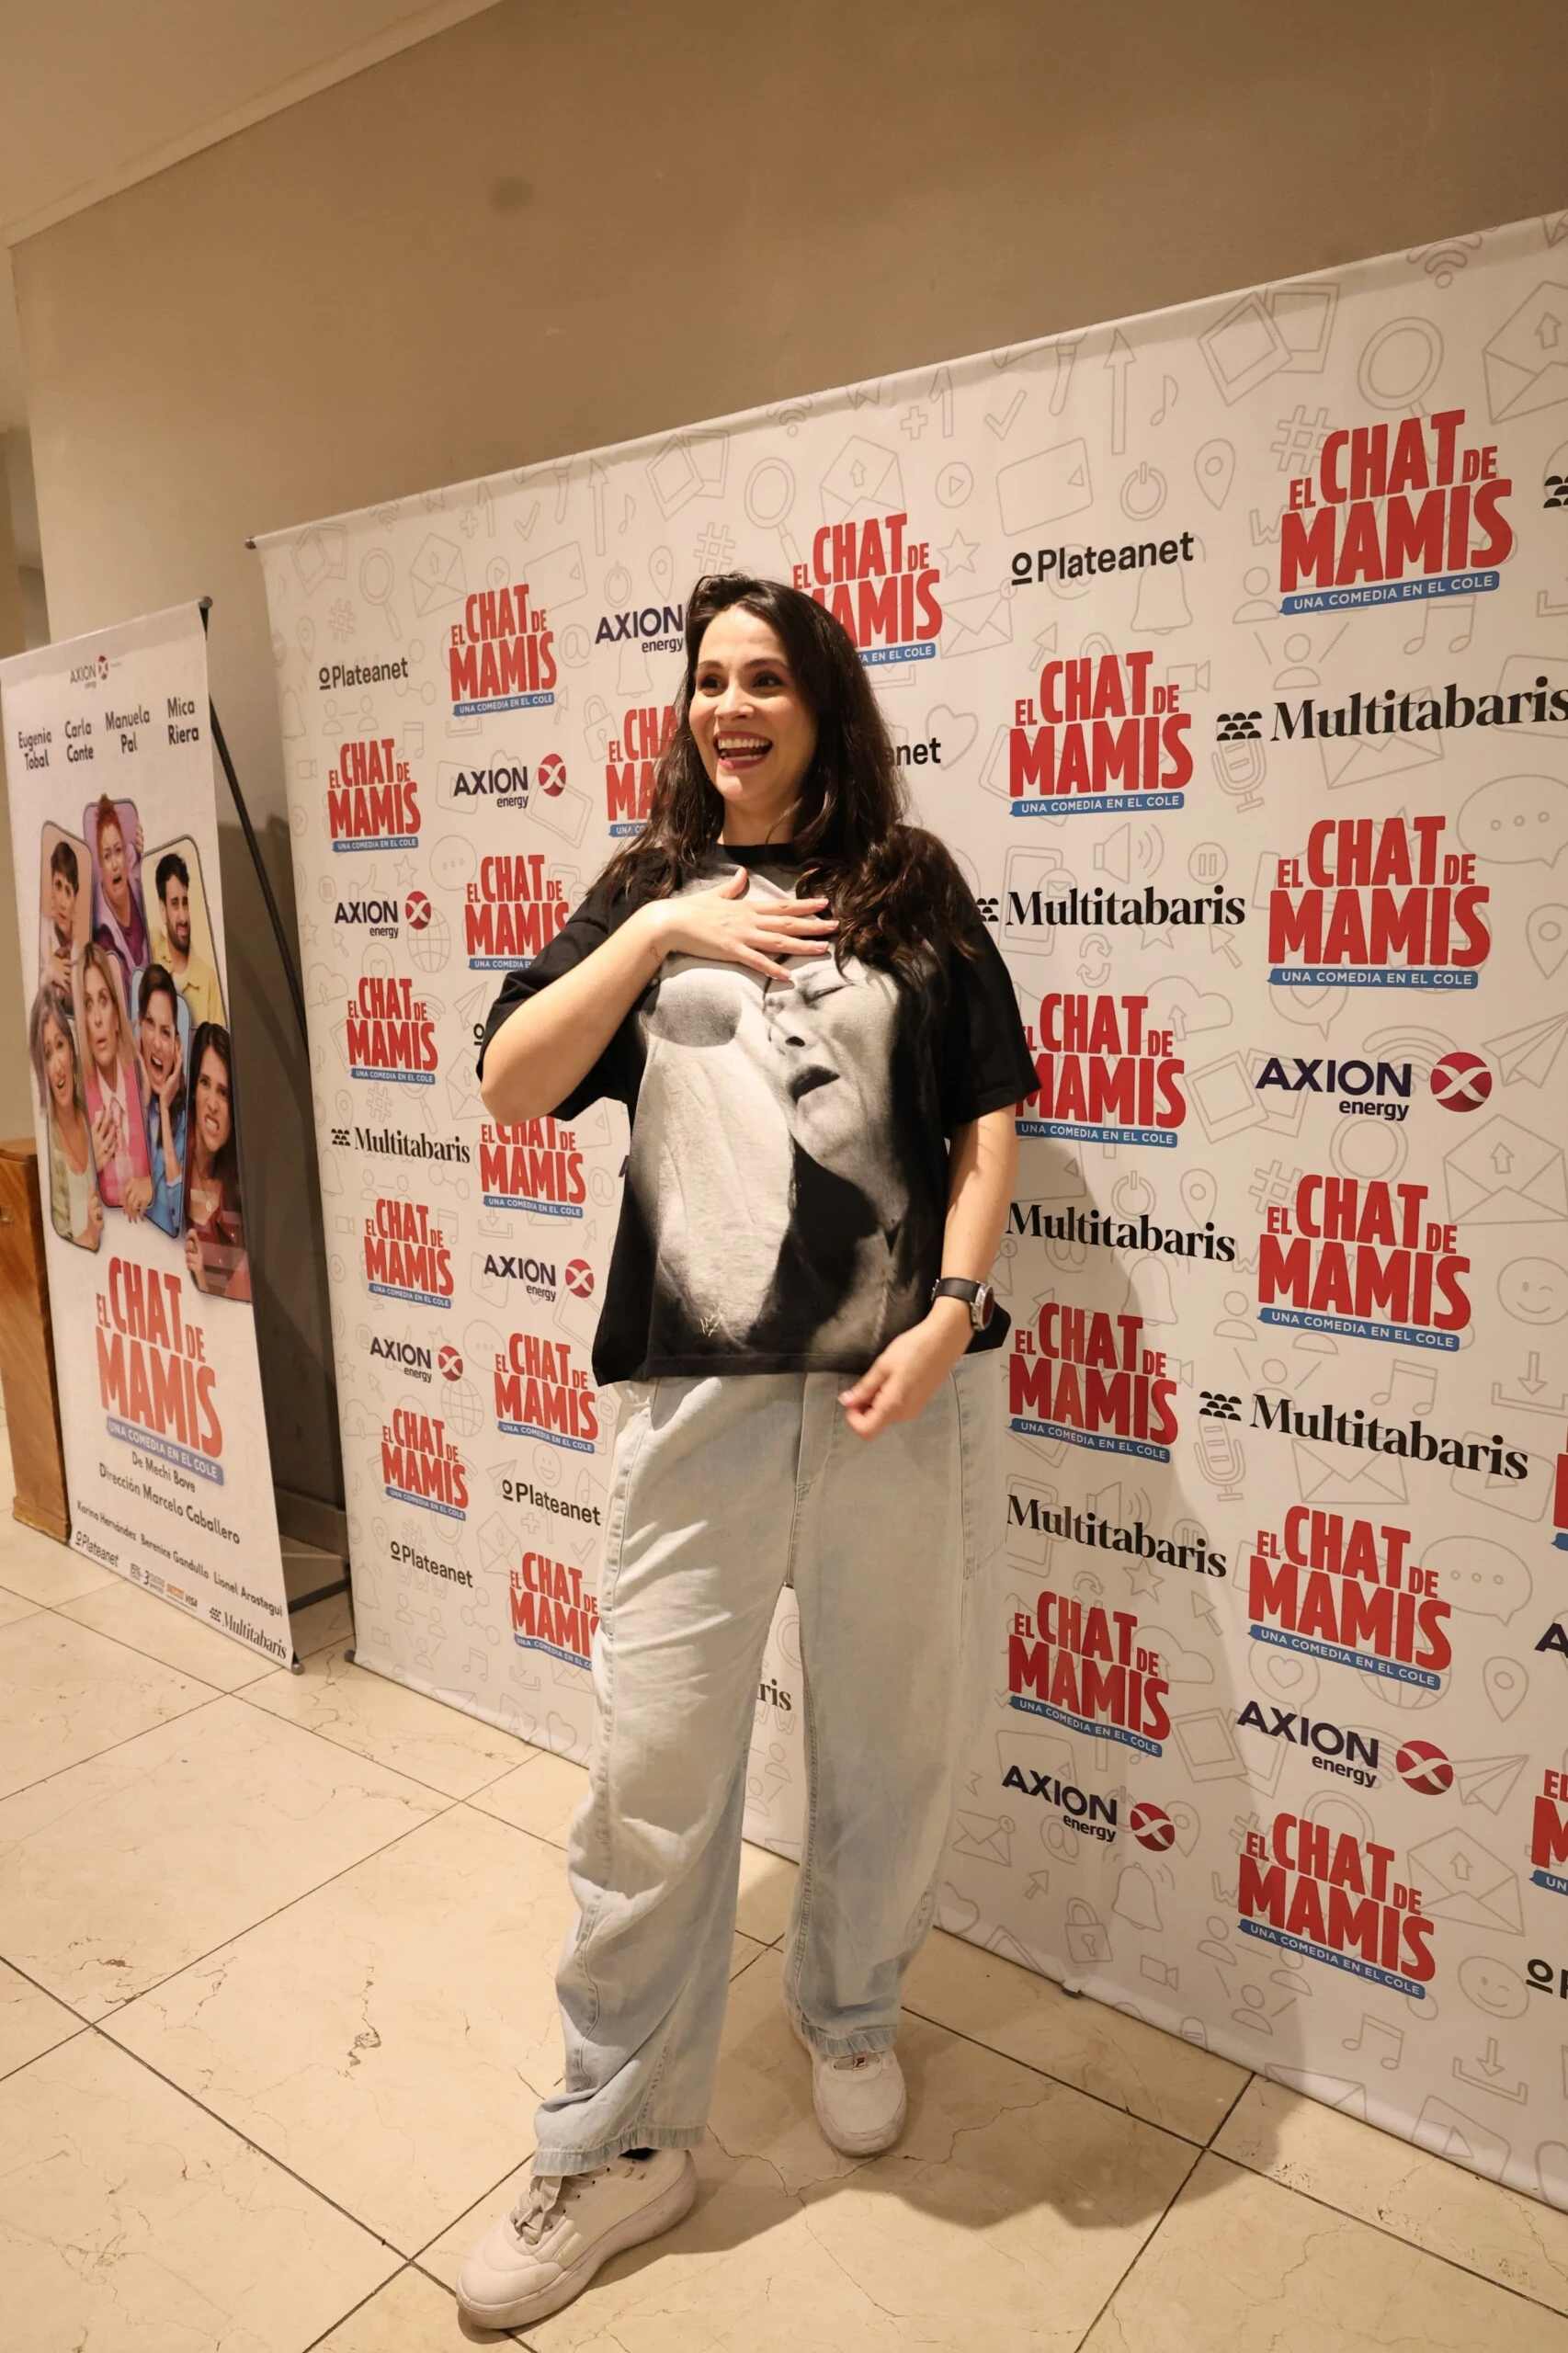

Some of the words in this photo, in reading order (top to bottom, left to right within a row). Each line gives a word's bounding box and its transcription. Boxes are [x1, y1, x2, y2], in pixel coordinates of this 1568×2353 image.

[1290, 478, 1314, 510] EL
[1320, 410, 1465, 505] CHAT
[1462, 446, 1496, 483] DE
[793, 563, 812, 591] EL
[812, 513, 907, 585] CHAT
[907, 542, 929, 572] DE
[1280, 479, 1512, 592] MAMIS
[452, 624, 465, 646] EL
[465, 585, 529, 643] CHAT
[530, 609, 547, 632] DE
[811, 569, 943, 648] AMIS
[1294, 597, 1324, 611] UNA
[1329, 588, 1397, 607] COMEDIA
[1403, 585, 1422, 597] EN
[1428, 582, 1445, 594] EL
[1451, 575, 1493, 591] COLE
[596, 605, 683, 643] AXION
[642, 637, 683, 654] energy
[449, 631, 558, 701] MAMIS
[1017, 699, 1036, 726] EL
[1040, 651, 1153, 724] CHAT
[1152, 684, 1179, 714] DE
[65, 720, 91, 739] Carla
[106, 705, 150, 732] Manuela
[167, 698, 195, 718] Mica
[168, 724, 199, 745] Riera
[608, 740, 623, 763] EL
[624, 706, 679, 761] CHA
[1271, 676, 1568, 741] Multitabaris
[18, 727, 51, 752] Eugenia
[24, 749, 49, 770] Tobal
[67, 744, 94, 763] Conte
[121, 733, 137, 754] Pal
[329, 770, 341, 790] EL
[340, 738, 395, 788] CHAT
[396, 762, 411, 782] DE
[1010, 713, 1193, 797] MAMIS
[454, 767, 528, 796] AXION
[497, 796, 528, 810] energy
[1022, 804, 1045, 813] UNA
[1050, 801, 1104, 813] COMEDIA
[1108, 799, 1123, 810] EN
[1128, 798, 1142, 808] EL
[1146, 796, 1179, 807] COLE
[328, 782, 421, 838] MAMIS
[467, 883, 481, 903] EL
[481, 855, 544, 903] CHAT
[546, 881, 562, 901] DE
[1278, 859, 1302, 888] EL
[1307, 816, 1446, 888] CHAT
[1443, 855, 1475, 885] DE
[335, 901, 398, 924] AXION
[369, 926, 399, 938] energy
[1006, 885, 1245, 925] Multitabaris
[1269, 886, 1490, 966] MAMIS
[347, 1001, 359, 1018] EL
[358, 977, 413, 1020] CHAT
[414, 1002, 427, 1021] DE
[1282, 973, 1311, 983] UNA
[1316, 972, 1381, 984] COMEDIA
[1387, 974, 1405, 984] EN
[1411, 974, 1427, 984] EL
[1433, 973, 1472, 985] COLE
[347, 1018, 437, 1071] MAMIS
[1022, 1026, 1038, 1051] L
[1040, 993, 1149, 1055] CHAT
[1148, 1030, 1174, 1057] DE
[1256, 1058, 1412, 1097] AXION
[481, 1124, 495, 1143] EL
[559, 1131, 576, 1151] DE
[1339, 1100, 1410, 1122] energy
[355, 1127, 470, 1164] Multitabaris
[480, 1143, 585, 1204] MAMIS
[365, 1219, 377, 1237] EL
[376, 1199, 429, 1245] CHAT
[430, 1229, 444, 1248] DE
[1006, 1202, 1235, 1262] Multitabaris
[1268, 1206, 1290, 1234] EL
[1296, 1174, 1428, 1248] CHAT
[1426, 1222, 1457, 1254] DE
[364, 1236, 454, 1296] MAMIS
[484, 1255, 555, 1286] AXION
[526, 1284, 556, 1302] energy
[1259, 1233, 1471, 1330] MAMIS
[96, 1293, 110, 1328] EL
[108, 1256, 183, 1354] CHAT
[186, 1324, 206, 1363] DE
[1272, 1313, 1299, 1325] UNA
[1303, 1316, 1366, 1336] COMEDIA
[1372, 1327, 1389, 1338] EN
[1395, 1330, 1410, 1341] EL
[1415, 1333, 1453, 1348] COLE
[370, 1337, 432, 1370] AXION
[497, 1352, 509, 1372] EL
[510, 1333, 571, 1385] CHAT
[572, 1370, 587, 1391] DE
[1017, 1330, 1034, 1356] EL
[1038, 1303, 1142, 1371] CHAT
[1142, 1349, 1166, 1378] DE
[96, 1325, 222, 1458] MAMIS
[403, 1367, 432, 1383] energy
[1010, 1354, 1179, 1445] MAMIS
[494, 1370, 597, 1439] MAMIS
[382, 1426, 393, 1444] EL
[392, 1408, 445, 1458] CHAT
[446, 1443, 460, 1463] DE
[1250, 1394, 1528, 1480] Multitabaris
[132, 1451, 143, 1468] De
[145, 1457, 171, 1480] Mechi
[381, 1442, 469, 1508] MAMIS
[99, 1462, 140, 1495] Dirección
[143, 1483, 183, 1516] Marcelo
[187, 1505, 240, 1544] Caballero
[1007, 1495, 1227, 1578] Multitabaris
[1258, 1531, 1279, 1560] EL
[1284, 1506, 1411, 1588] CHAT
[1408, 1566, 1438, 1598] DE
[214, 1572, 239, 1596] Lionel
[510, 1570, 522, 1589] EL
[522, 1552, 582, 1608] CHAT
[584, 1594, 597, 1615] DE
[222, 1612, 287, 1660] Multitabaris
[1016, 1613, 1033, 1639] EL
[1036, 1592, 1137, 1667] CHAT
[1135, 1648, 1160, 1677] DE
[1249, 1555, 1451, 1671] MAMIS
[1010, 1634, 1171, 1740] MAMIS
[1236, 1701, 1379, 1768] AXION
[1002, 1766, 1117, 1826] AXION
[1312, 1755, 1377, 1789] energy
[1063, 1813, 1116, 1843] energy
[1247, 1833, 1267, 1861] EL
[1272, 1813, 1395, 1902] CHAT
[1392, 1882, 1422, 1915] DE
[1239, 1854, 1435, 1982] MAMIS
